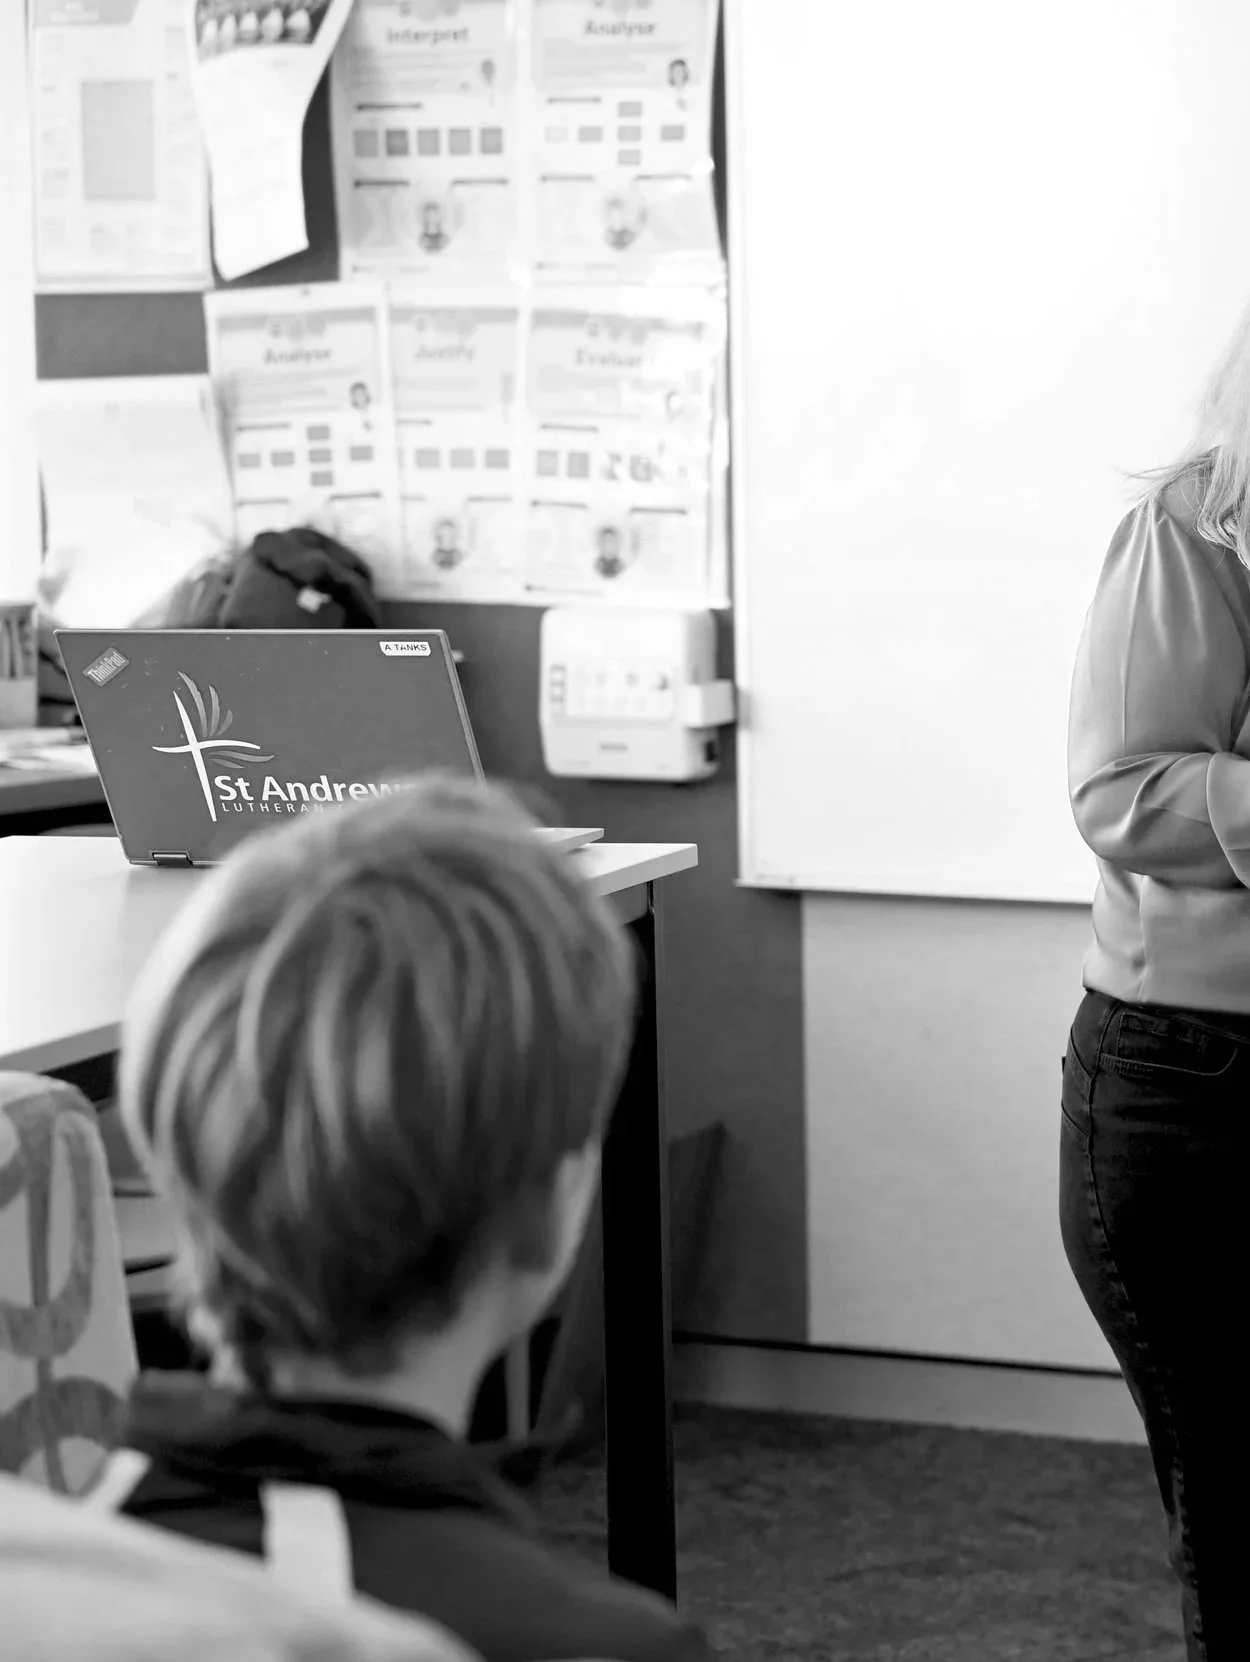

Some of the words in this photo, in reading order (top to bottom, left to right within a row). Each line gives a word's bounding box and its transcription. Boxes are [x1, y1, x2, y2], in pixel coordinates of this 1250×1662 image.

[387, 27, 468, 46] Interpret
[87, 651, 125, 682] ThinkPad
[214, 775, 254, 801] St
[262, 775, 402, 801] Andrew
[222, 802, 323, 813] LUTHERAN
